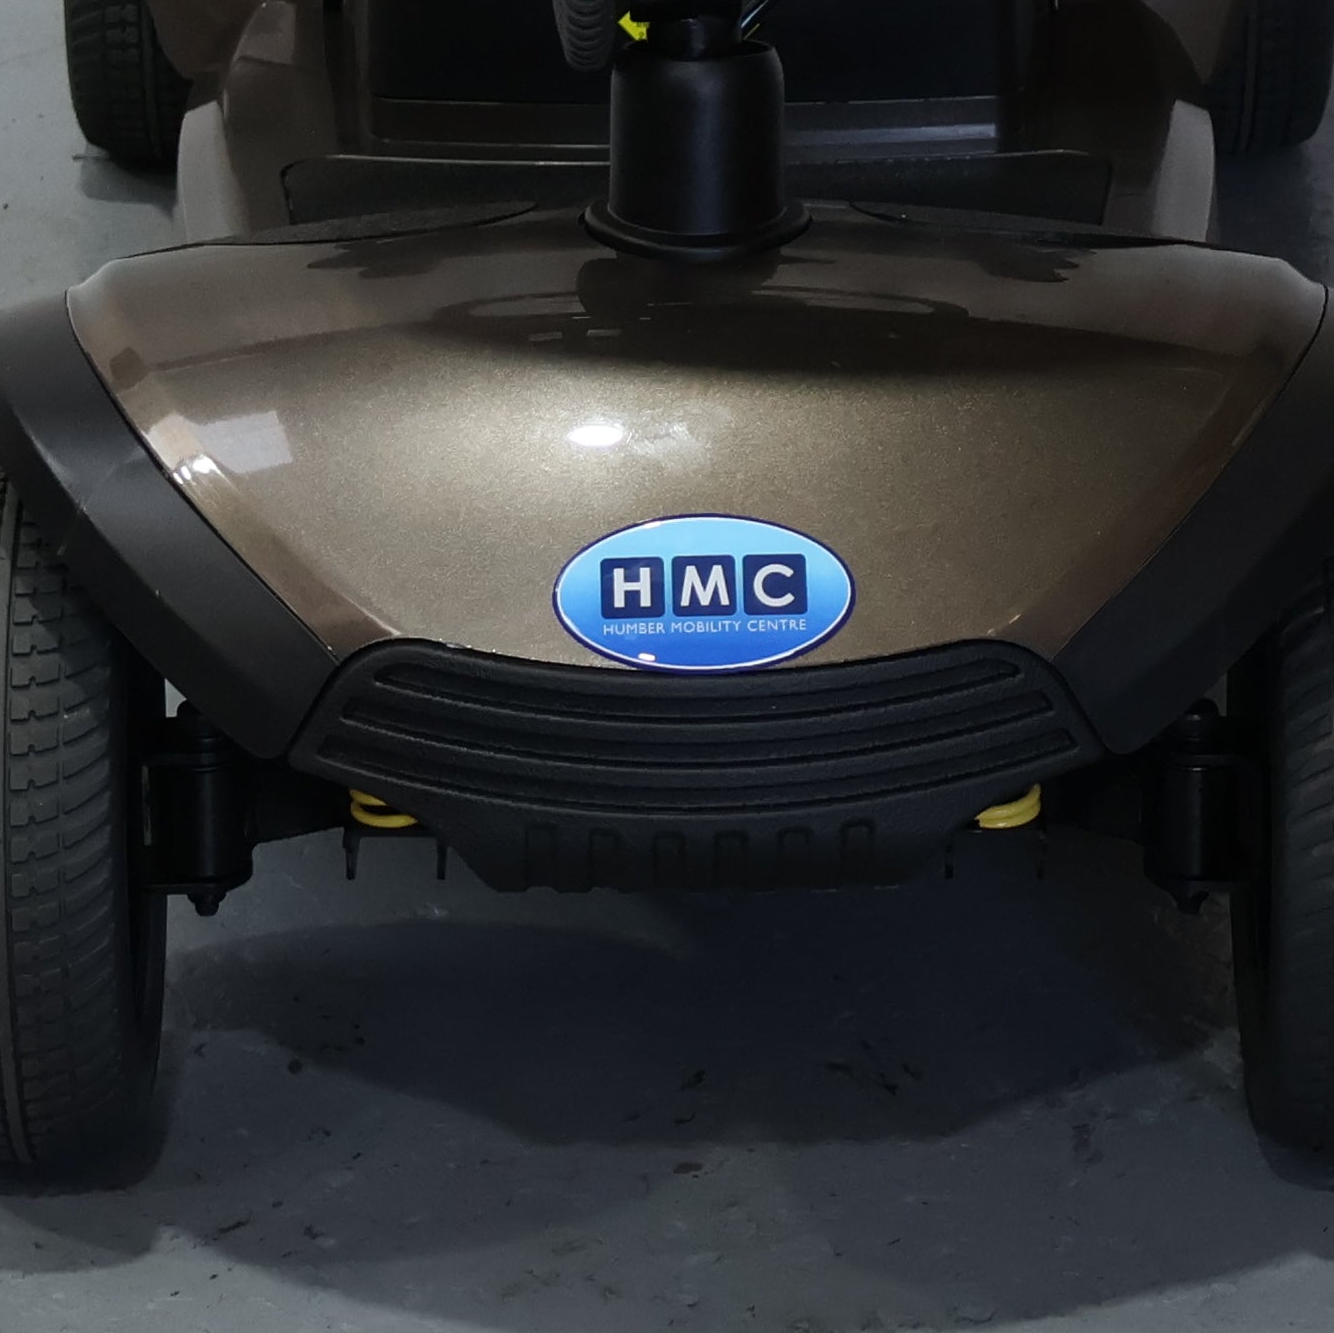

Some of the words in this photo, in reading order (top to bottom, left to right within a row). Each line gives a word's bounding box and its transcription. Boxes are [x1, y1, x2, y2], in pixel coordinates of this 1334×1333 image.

[613, 564, 795, 608] HMC
[603, 622, 665, 636] HUMBER
[671, 619, 741, 634] MOBILITY
[747, 618, 807, 632] CENTRE
